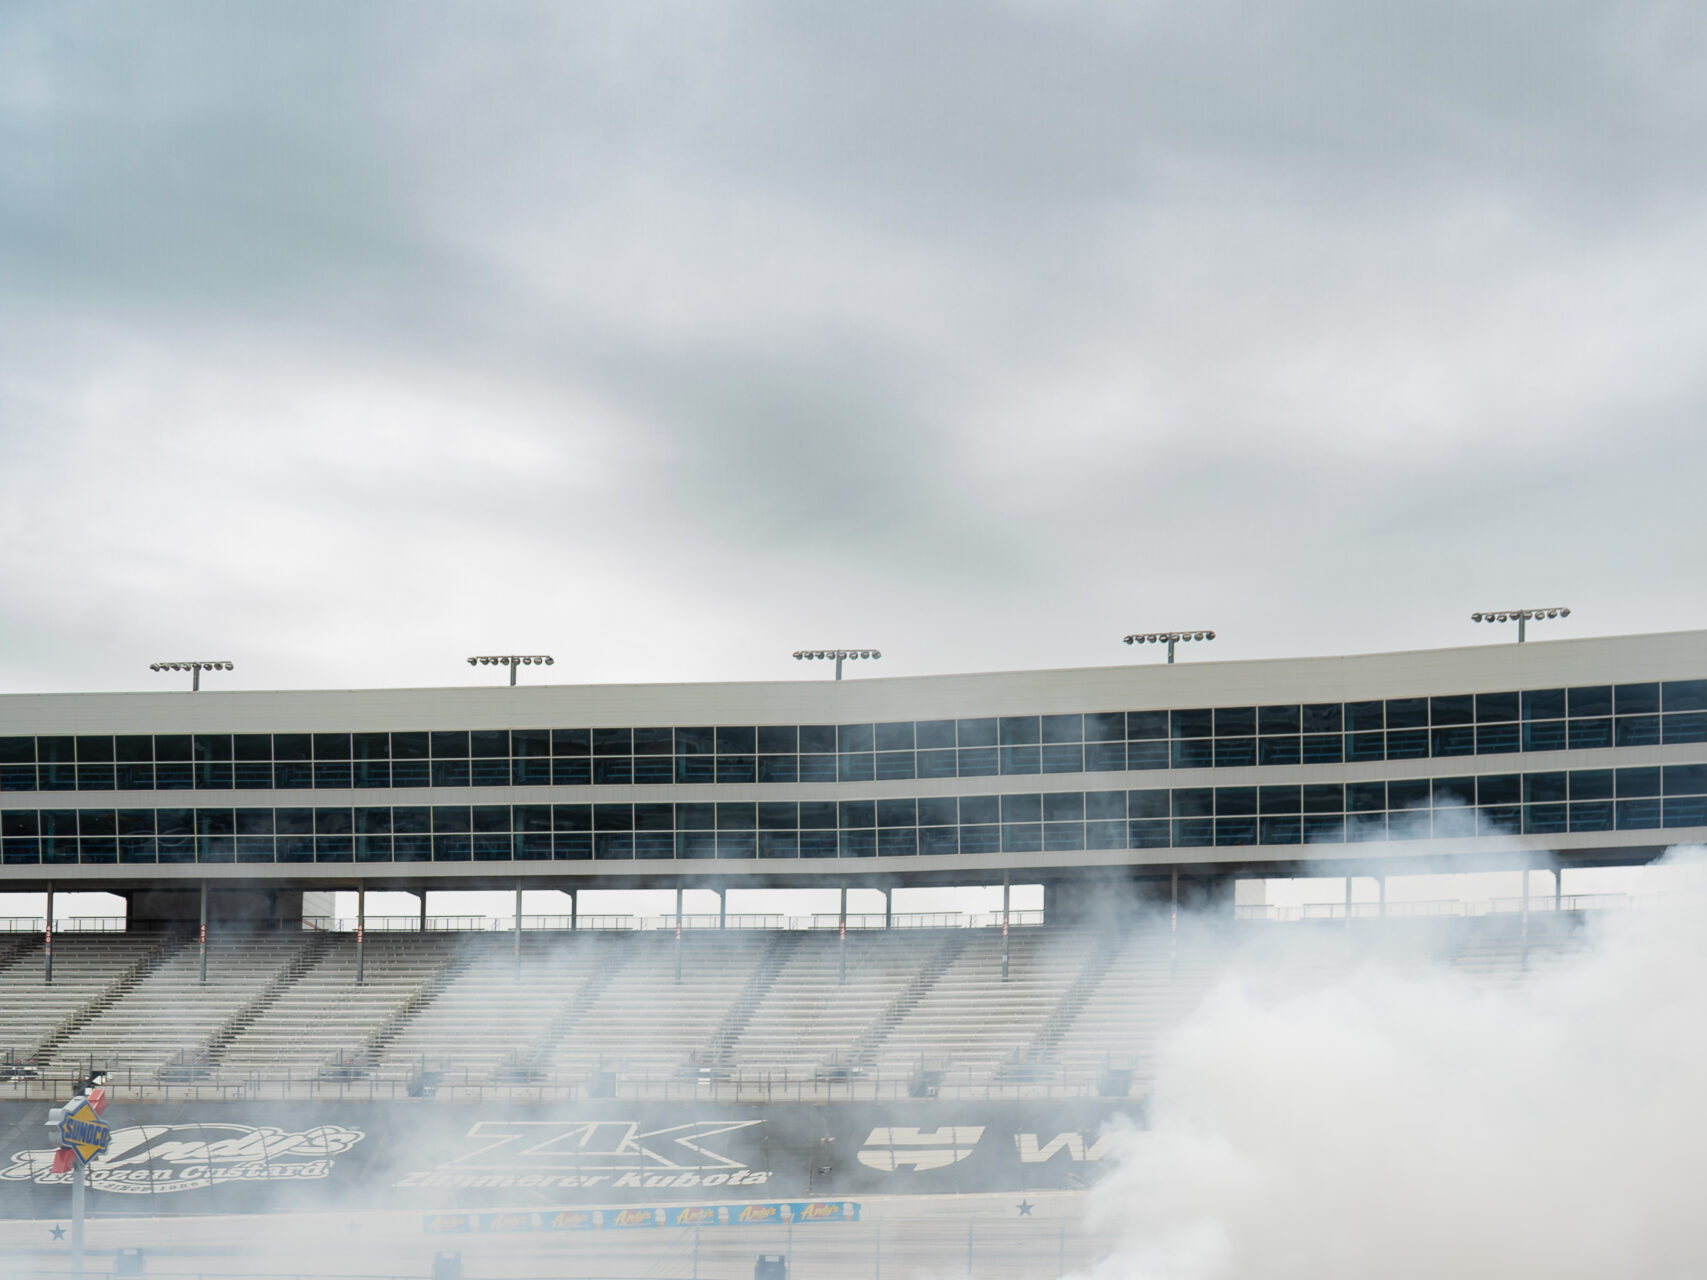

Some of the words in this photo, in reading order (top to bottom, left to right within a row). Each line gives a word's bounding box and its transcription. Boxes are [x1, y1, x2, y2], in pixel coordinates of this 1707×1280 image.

[65, 1118, 110, 1149] SUNOCO
[179, 1161, 329, 1180] Custard
[394, 1171, 610, 1188] Zimmerer
[612, 1168, 773, 1188] Kubota
